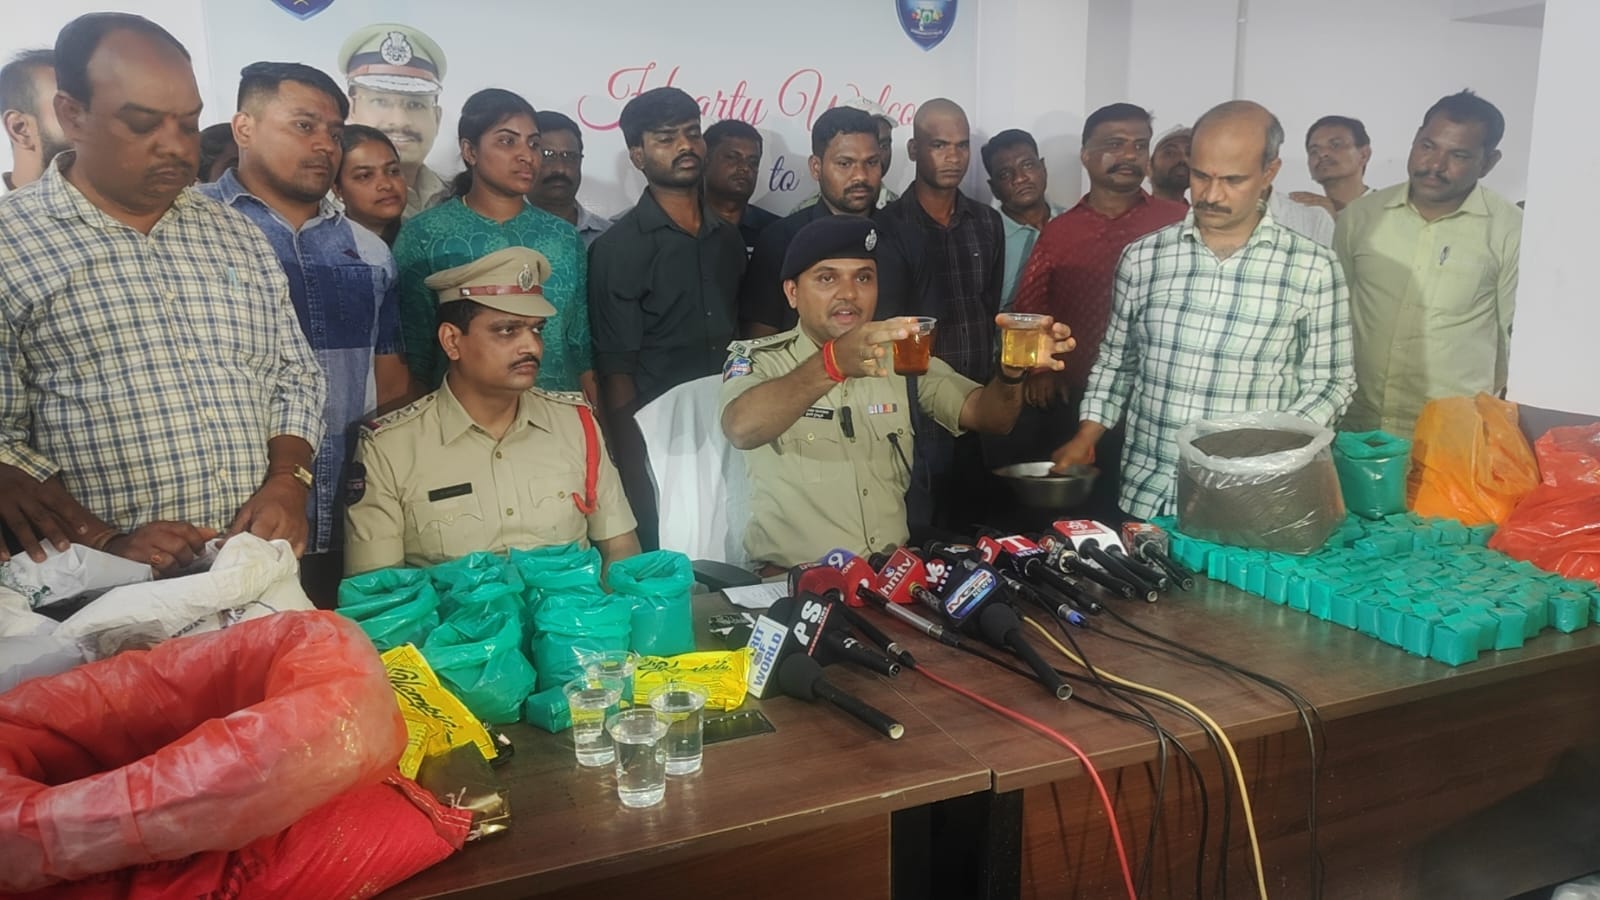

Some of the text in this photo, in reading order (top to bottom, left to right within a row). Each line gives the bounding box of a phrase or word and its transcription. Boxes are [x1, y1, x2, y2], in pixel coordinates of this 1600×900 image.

[577, 62, 915, 131] Harty Wlco
[769, 155, 800, 193] to
[827, 552, 845, 569] 9
[880, 557, 912, 596] hmtv
[925, 562, 945, 583] V6
[750, 626, 765, 651] RIT
[793, 600, 823, 647] PS
[753, 632, 783, 687] WORLD
